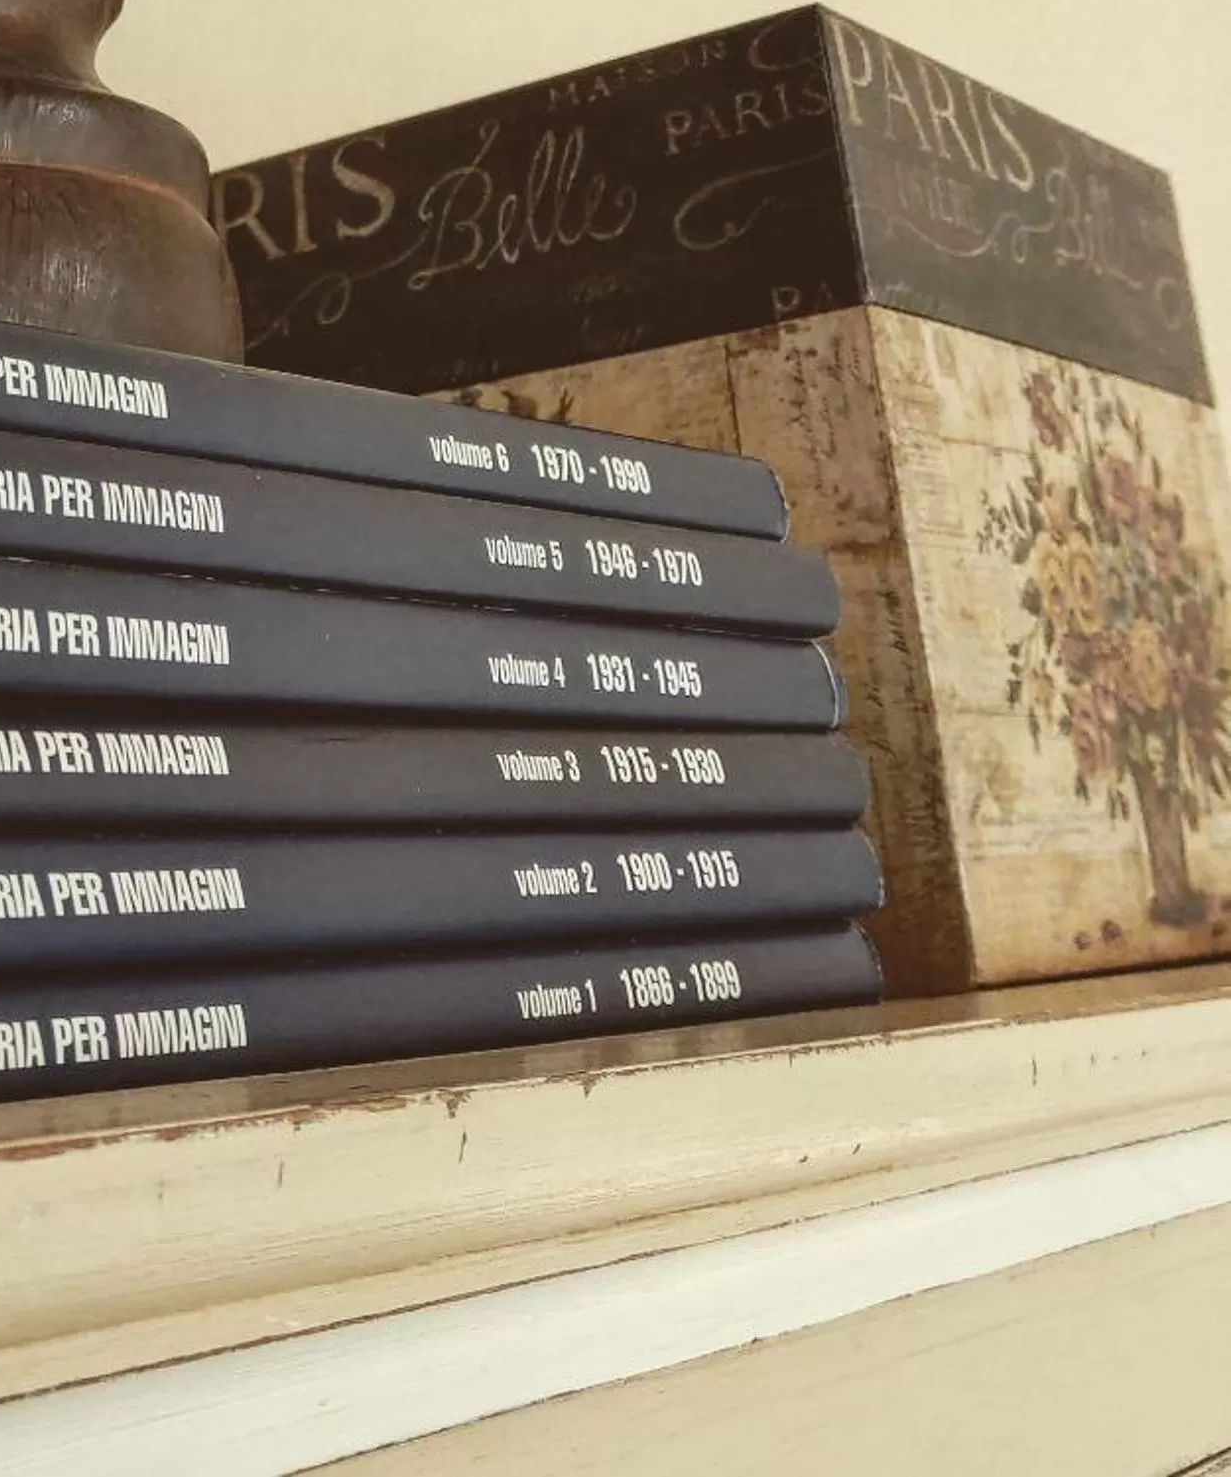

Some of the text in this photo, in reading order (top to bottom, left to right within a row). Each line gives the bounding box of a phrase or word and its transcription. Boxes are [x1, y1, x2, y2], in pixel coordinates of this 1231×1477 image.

[828, 12, 1036, 192] PARIS
[43, 364, 169, 419] IMMAGINI
[429, 435, 493, 470] volume
[496, 443, 510, 473] 6
[531, 444, 585, 485] 1970
[599, 455, 652, 495] 1990
[41, 475, 95, 519] PER
[100, 481, 225, 534] IMMAGINI
[484, 534, 547, 569] volume
[550, 540, 564, 572] 5
[585, 539, 638, 580] 1946
[651, 547, 703, 587] 1970
[47, 610, 101, 657] PER
[105, 615, 230, 665] IMMAGINI
[488, 653, 551, 688] volume
[552, 657, 566, 689] 4
[586, 652, 636, 693] 1931
[653, 659, 702, 698] 1945
[38, 730, 94, 774] PER
[99, 732, 230, 776] IMMAGINI
[496, 749, 564, 782] volume
[565, 750, 581, 782] 3
[599, 745, 657, 784] 1915
[671, 747, 726, 785] 1930
[50, 870, 109, 918] PER
[112, 867, 246, 915] IMMAGINI
[514, 863, 580, 897] volume
[581, 860, 598, 894] 2
[616, 852, 672, 892] 1900
[687, 850, 740, 889] 1915
[517, 984, 582, 1019] volume
[584, 978, 598, 1012] 1
[619, 965, 675, 1009] 1866
[689, 959, 742, 1002] 1899
[51, 1015, 110, 1065] PER
[114, 1003, 247, 1059] IMMAGINI
